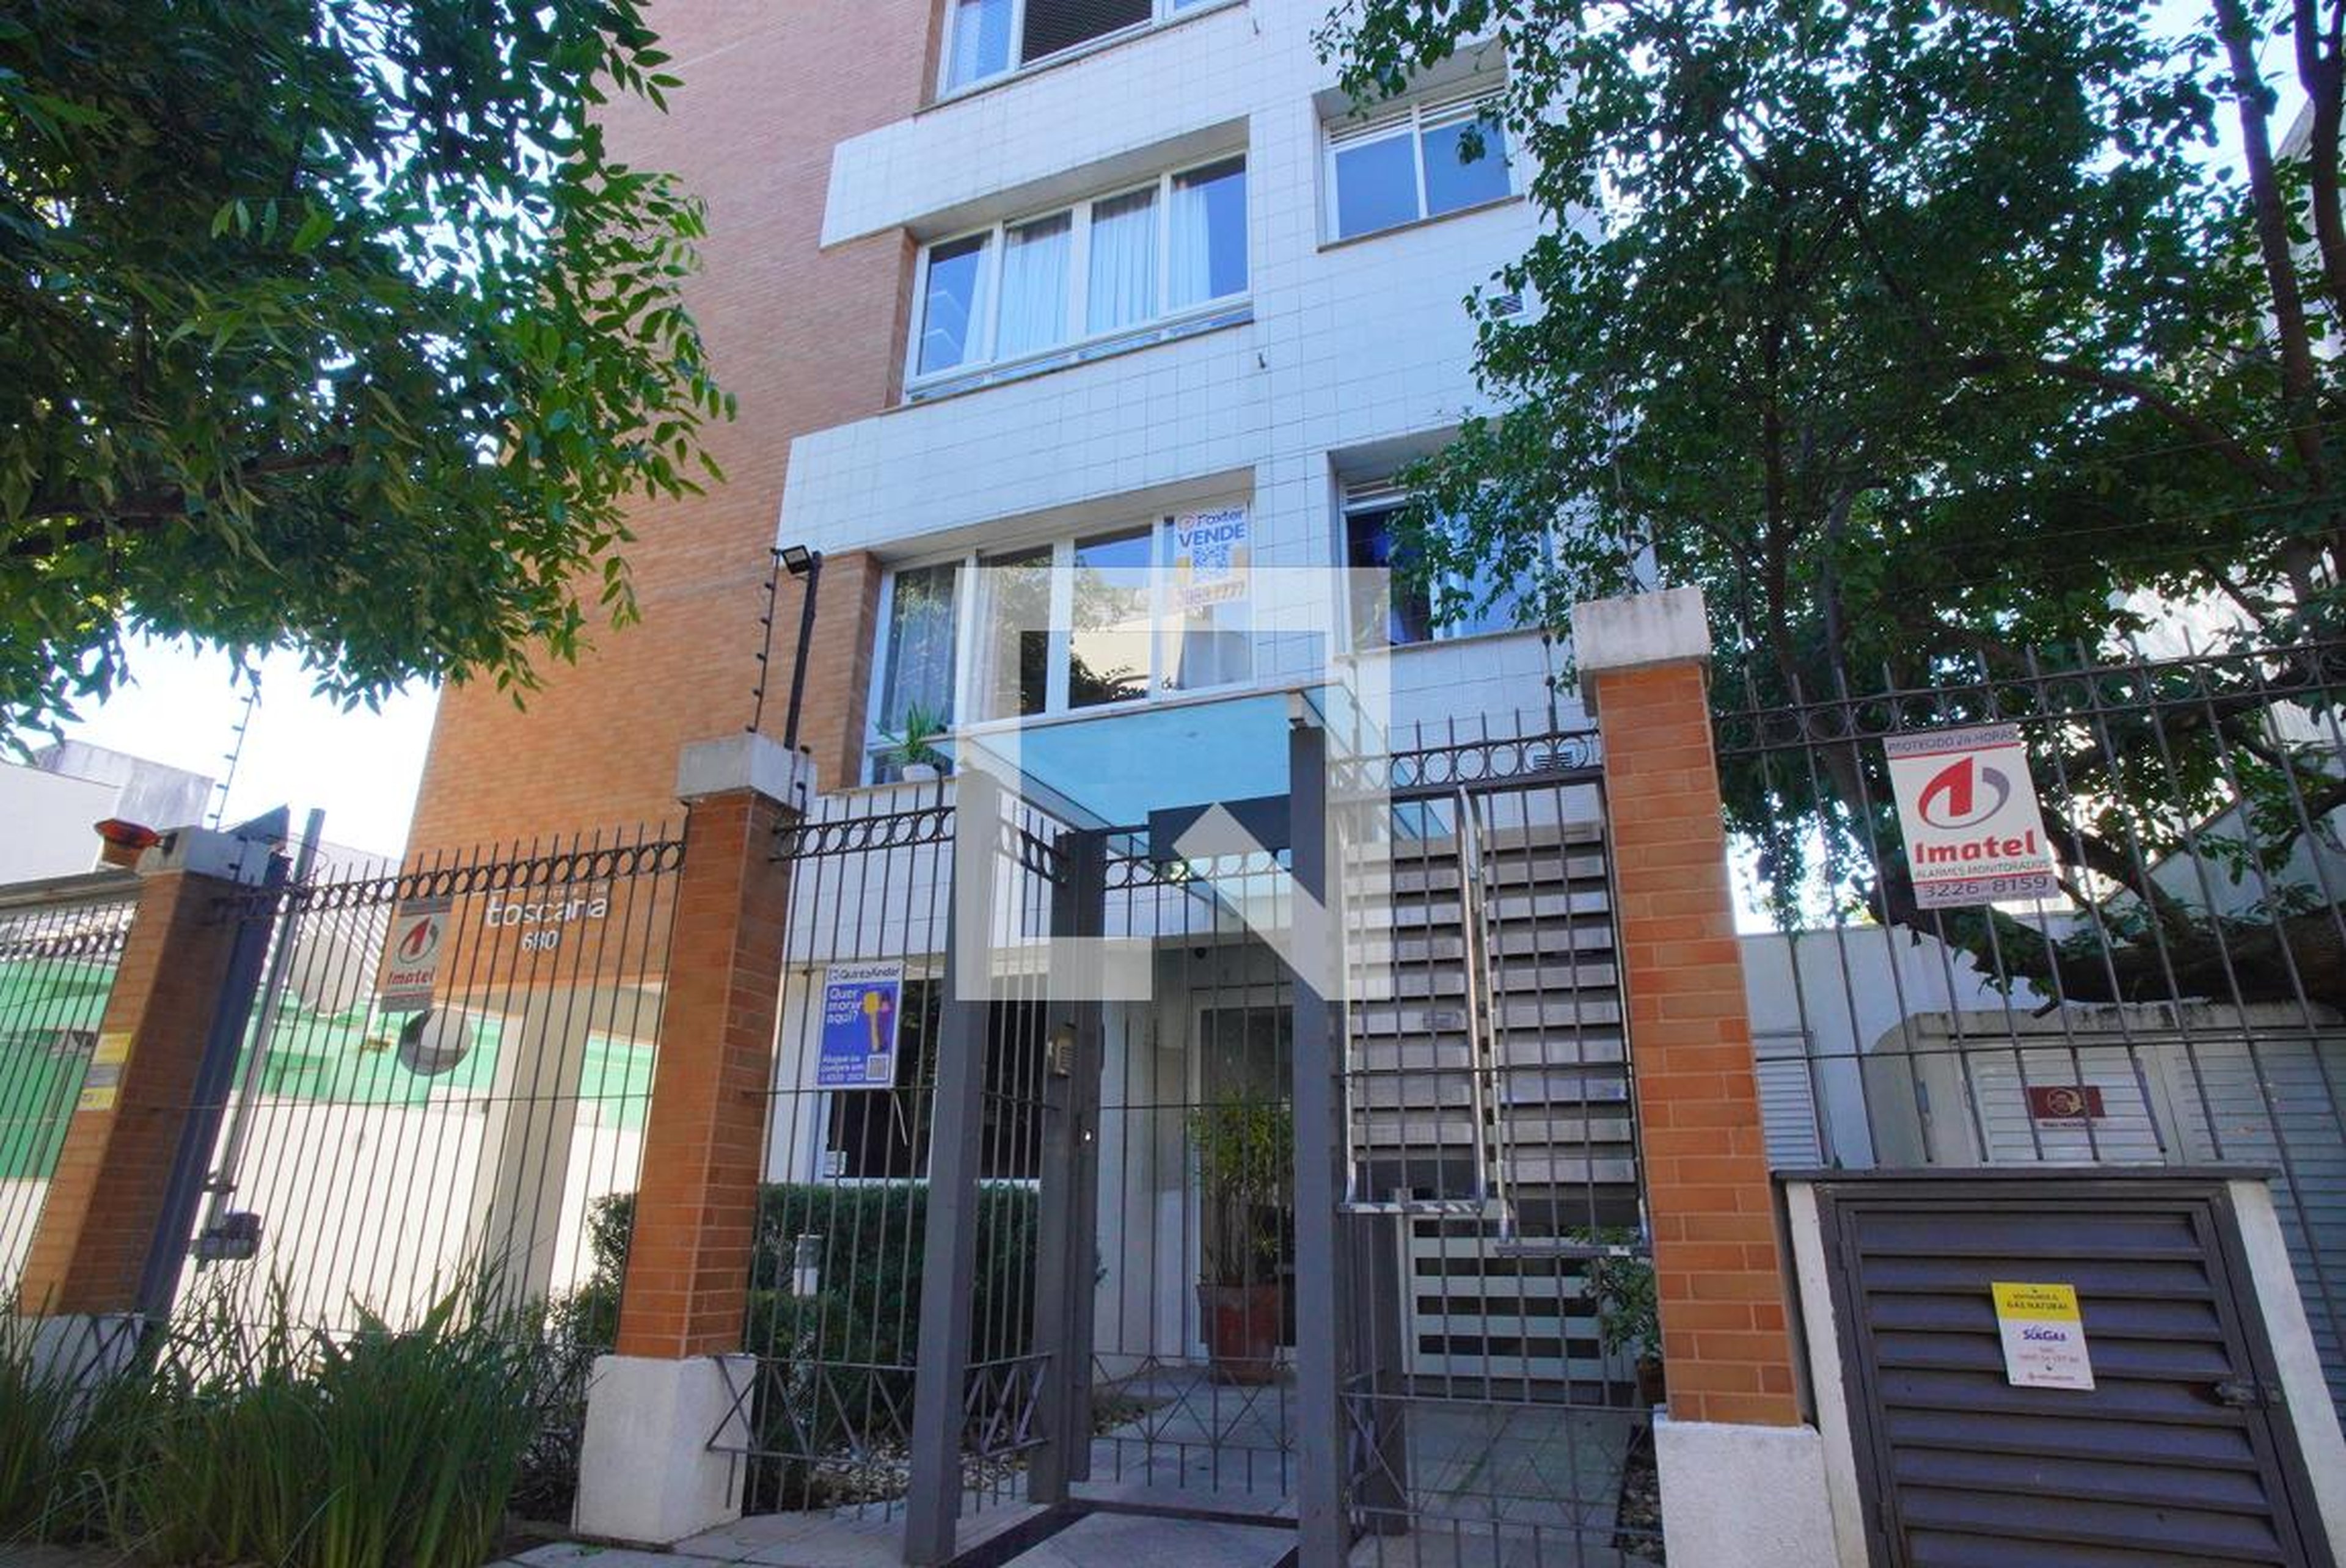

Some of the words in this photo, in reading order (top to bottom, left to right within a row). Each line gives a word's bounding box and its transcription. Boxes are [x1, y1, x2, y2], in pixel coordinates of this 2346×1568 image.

[1179, 523, 1245, 548] VENDE
[1915, 830, 2037, 864] Imatel
[1925, 881, 1979, 897] 3226
[1992, 875, 2047, 893] 8159
[487, 895, 607, 927] toscana
[829, 987, 858, 1001] Quer
[827, 1010, 858, 1025] aqui?
